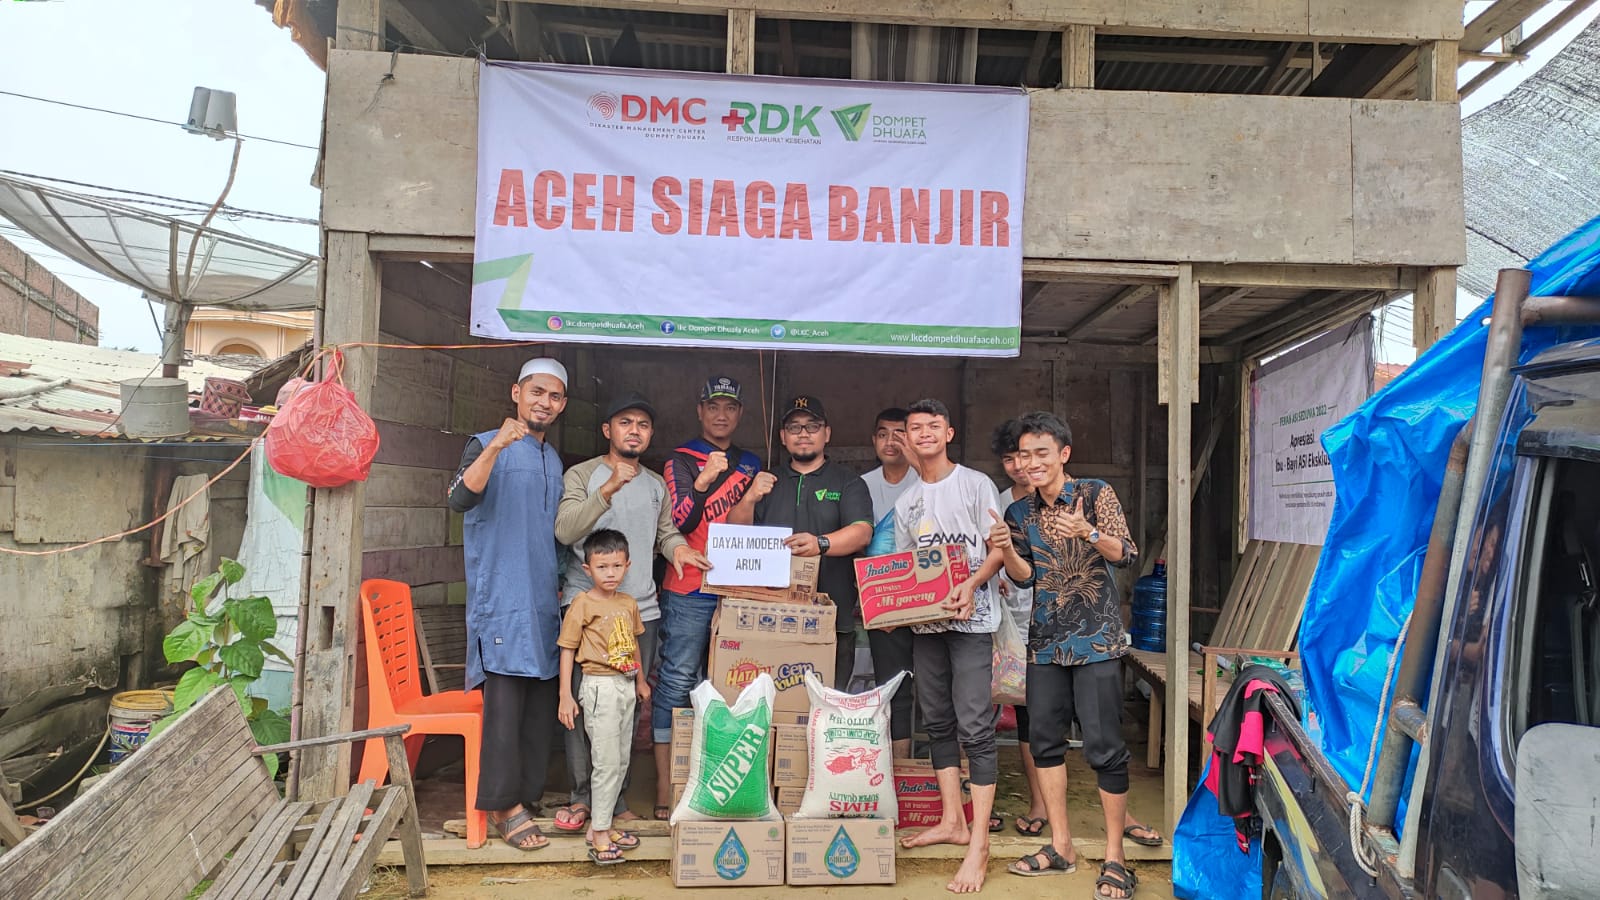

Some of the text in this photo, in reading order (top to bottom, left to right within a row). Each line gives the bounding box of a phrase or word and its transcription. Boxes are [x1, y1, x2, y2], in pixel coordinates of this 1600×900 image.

[621, 94, 707, 125] DMC
[730, 101, 823, 137] RDK
[872, 115, 927, 127] DOMPET
[589, 122, 623, 130] DISASTER
[627, 126, 675, 134] MANAGEMENT
[872, 127, 927, 139] DHUAFA
[492, 168, 1010, 248] ACEH SIAGA BANJIR
[1290, 429, 1315, 451] Apresiasi
[1275, 458, 1284, 472] Ibu
[1287, 455, 1298, 474] Bayi
[1299, 454, 1307, 469] ASI
[712, 536, 786, 550] DAYAH MODERN
[736, 558, 761, 571] ARUN
[877, 591, 936, 607] Mi goreng
[710, 728, 764, 804] SUPER
[829, 792, 879, 802] SUPER QUALITY
[830, 800, 878, 812] HMS
